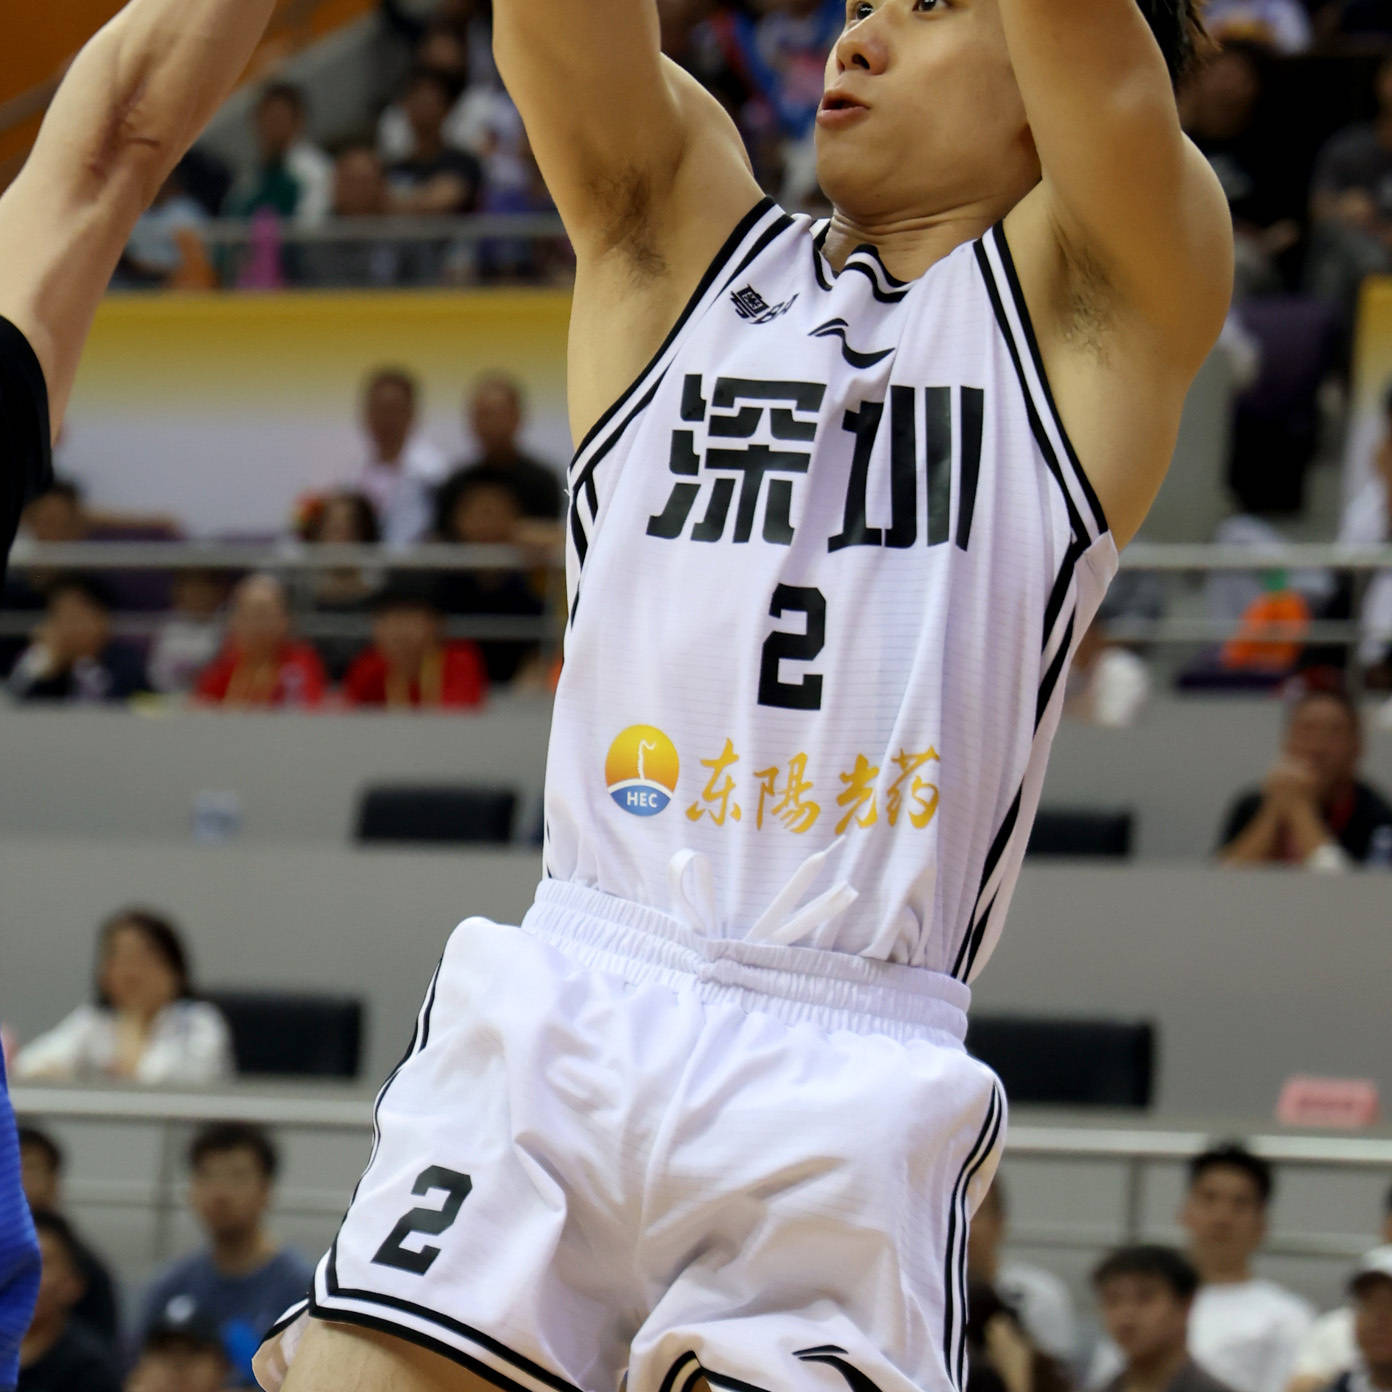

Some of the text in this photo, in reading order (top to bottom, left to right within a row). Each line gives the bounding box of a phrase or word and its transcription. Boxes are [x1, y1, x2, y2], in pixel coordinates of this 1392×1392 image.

[645, 372, 985, 553] 深圳
[756, 582, 827, 711] 2
[626, 791, 658, 808] HEC
[371, 1164, 473, 1276] 2
